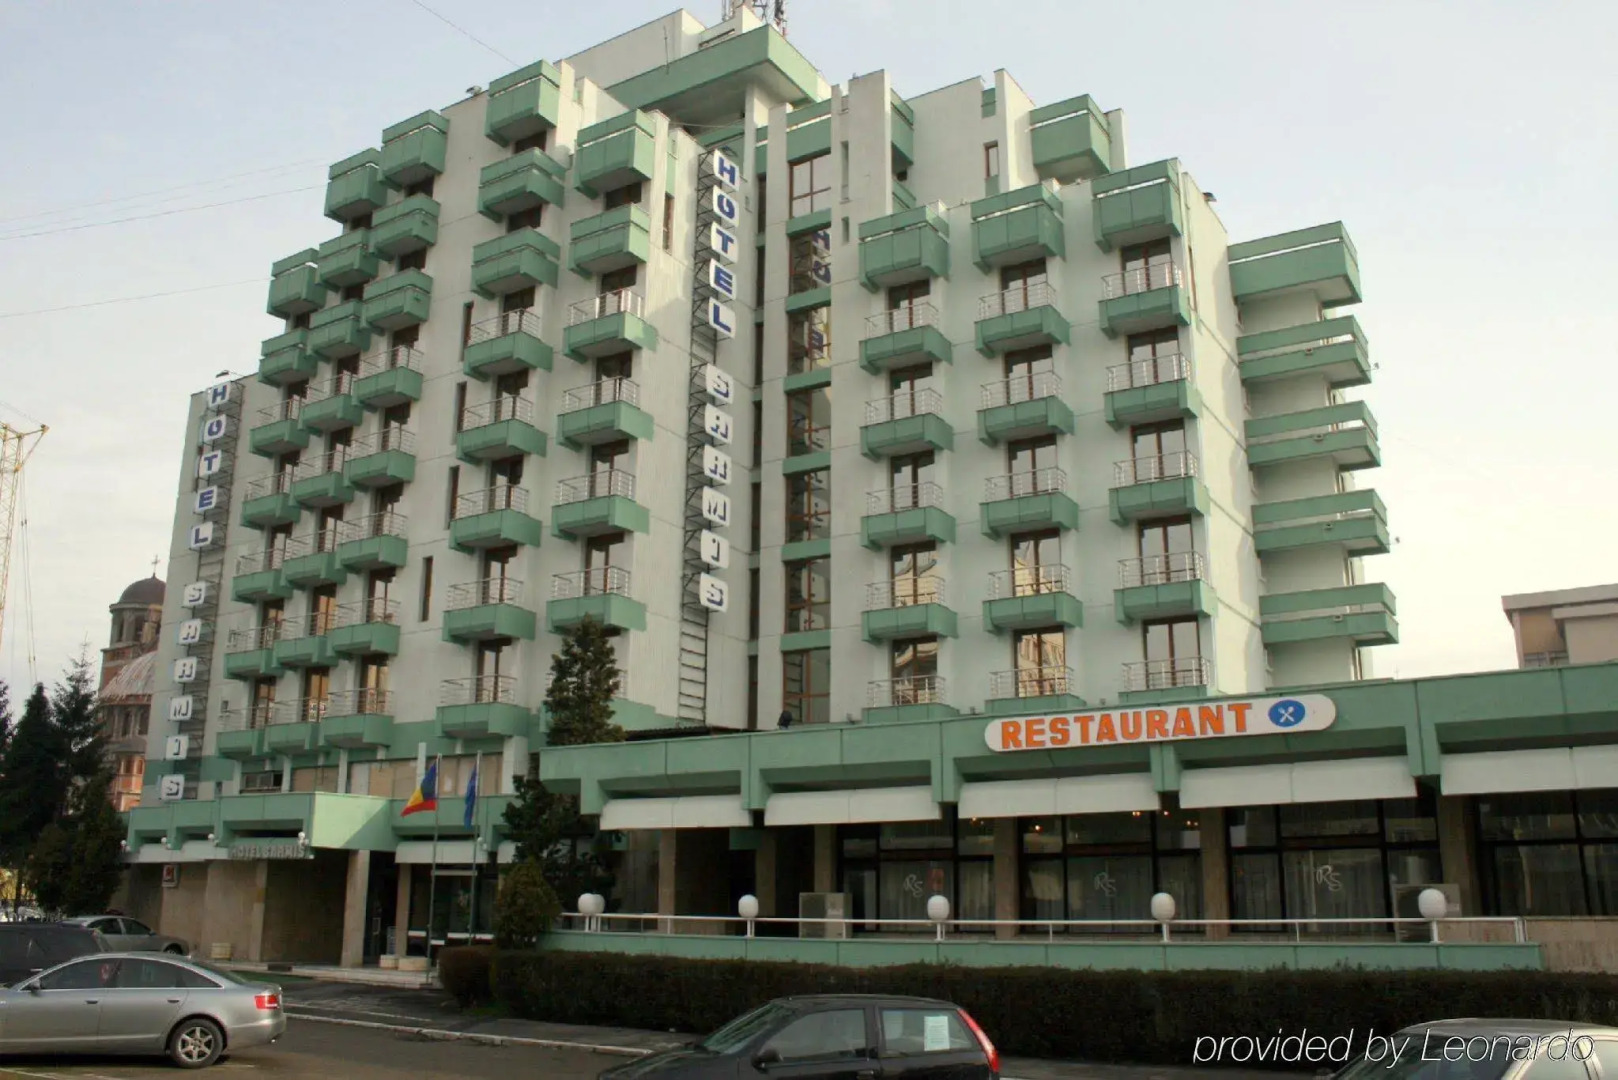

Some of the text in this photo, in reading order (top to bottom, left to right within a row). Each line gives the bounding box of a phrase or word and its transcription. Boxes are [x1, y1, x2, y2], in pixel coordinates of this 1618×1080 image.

[705, 154, 738, 609] HOTEL SARMIS
[193, 383, 229, 546] HOTEL
[1000, 702, 1252, 750] RESTAURANT
